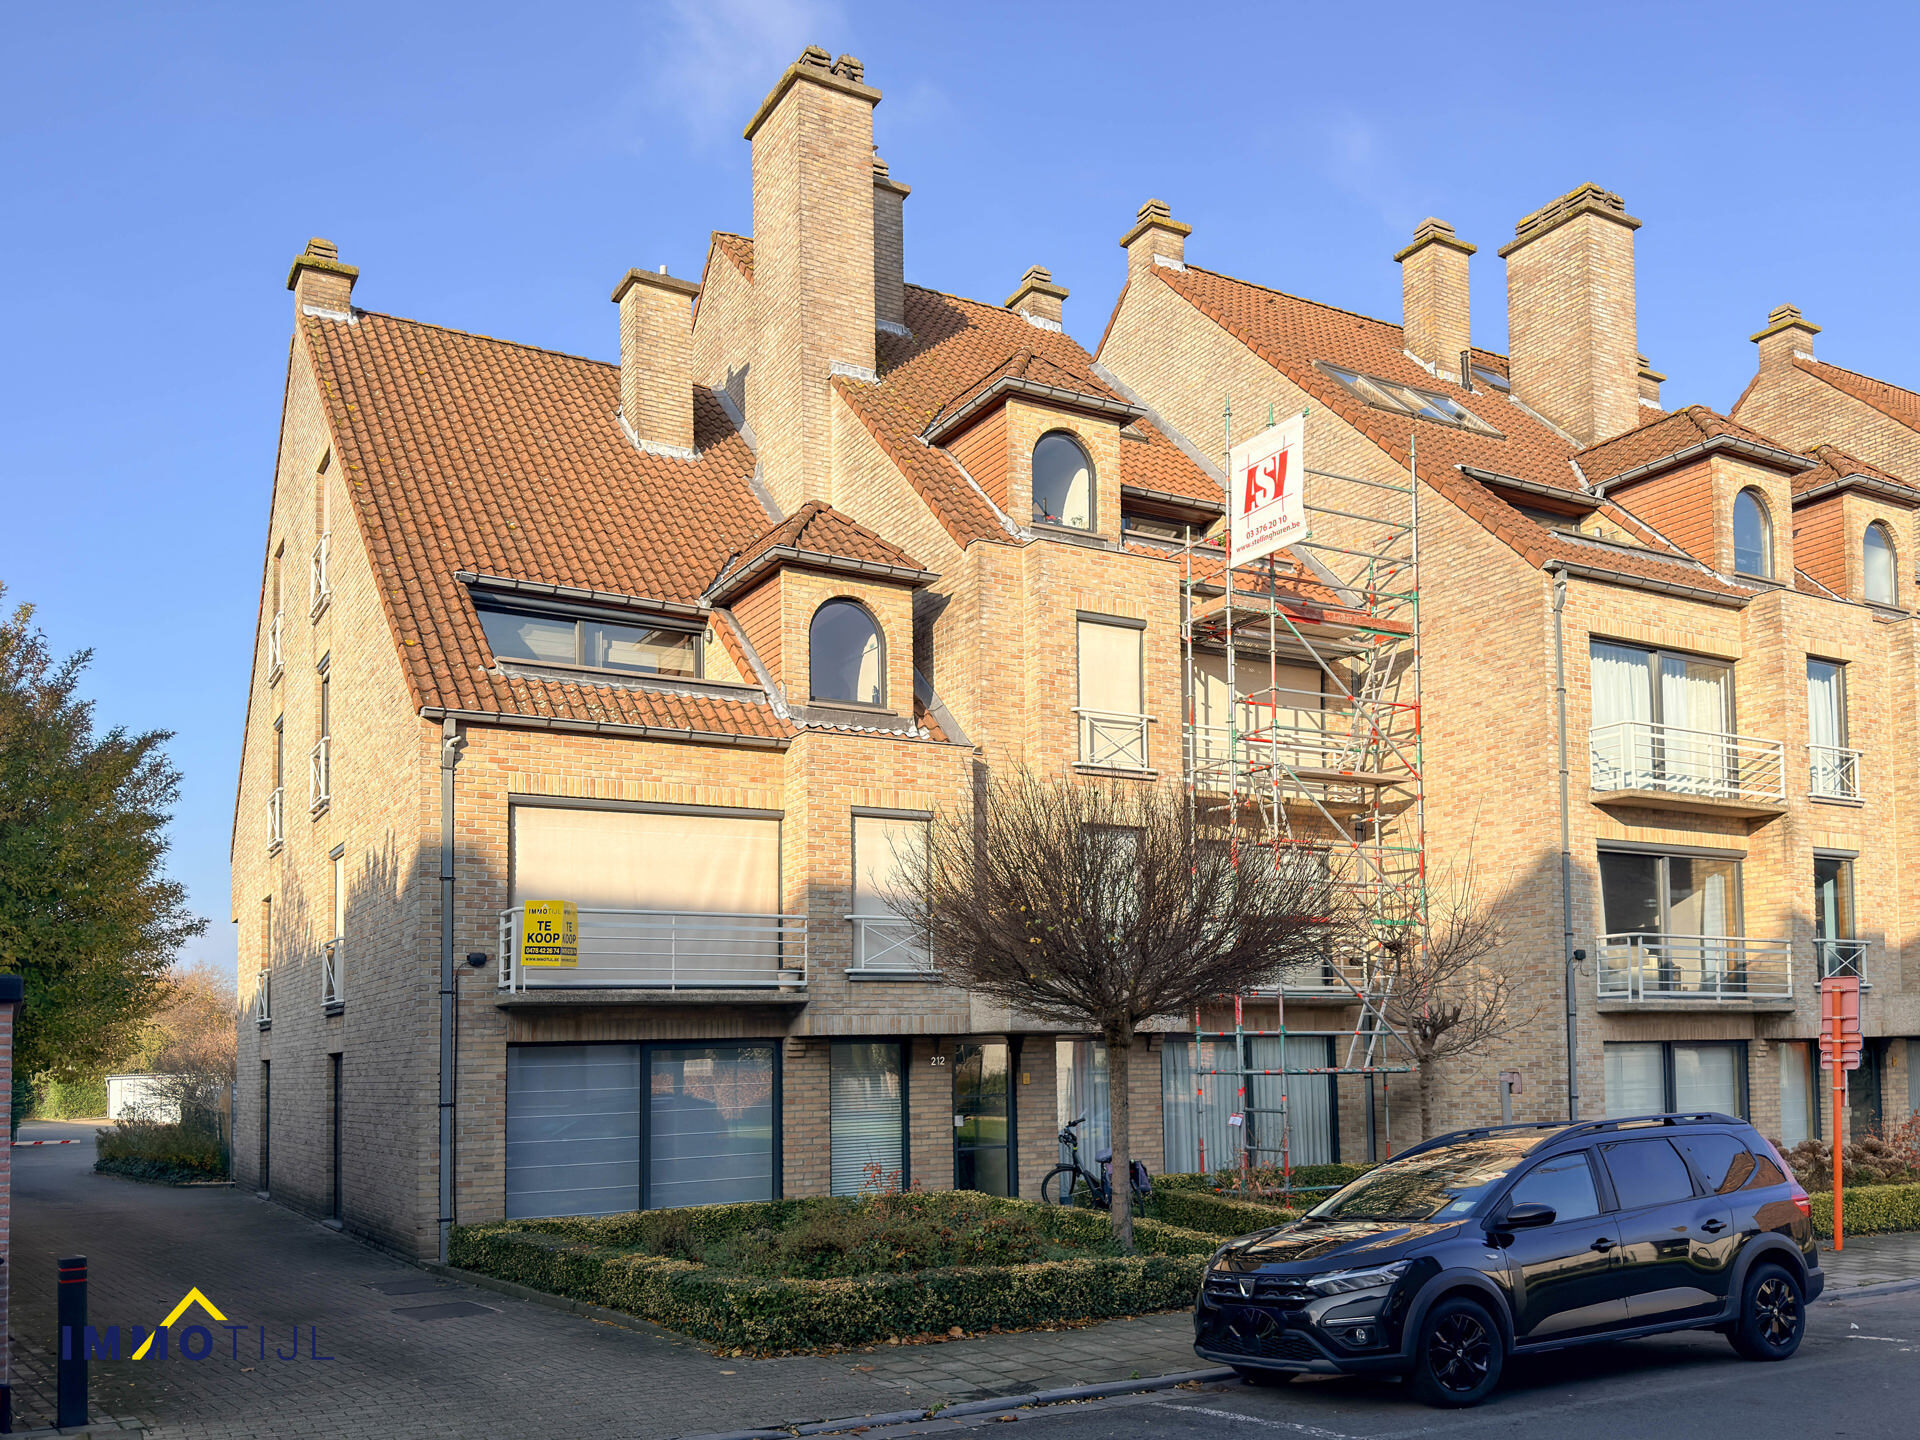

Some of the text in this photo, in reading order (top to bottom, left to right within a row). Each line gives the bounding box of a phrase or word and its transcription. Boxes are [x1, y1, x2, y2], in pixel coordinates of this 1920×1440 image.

[1244, 449, 1288, 514] ASV
[1246, 514, 1287, 539] 03 376 20 10
[1236, 521, 1300, 552] www.stellinghuren.be
[537, 921, 552, 931] TE
[566, 921, 572, 932] TE
[527, 932, 560, 943] KOOP
[562, 934, 576, 945] KOOP
[931, 1056, 945, 1066] 212
